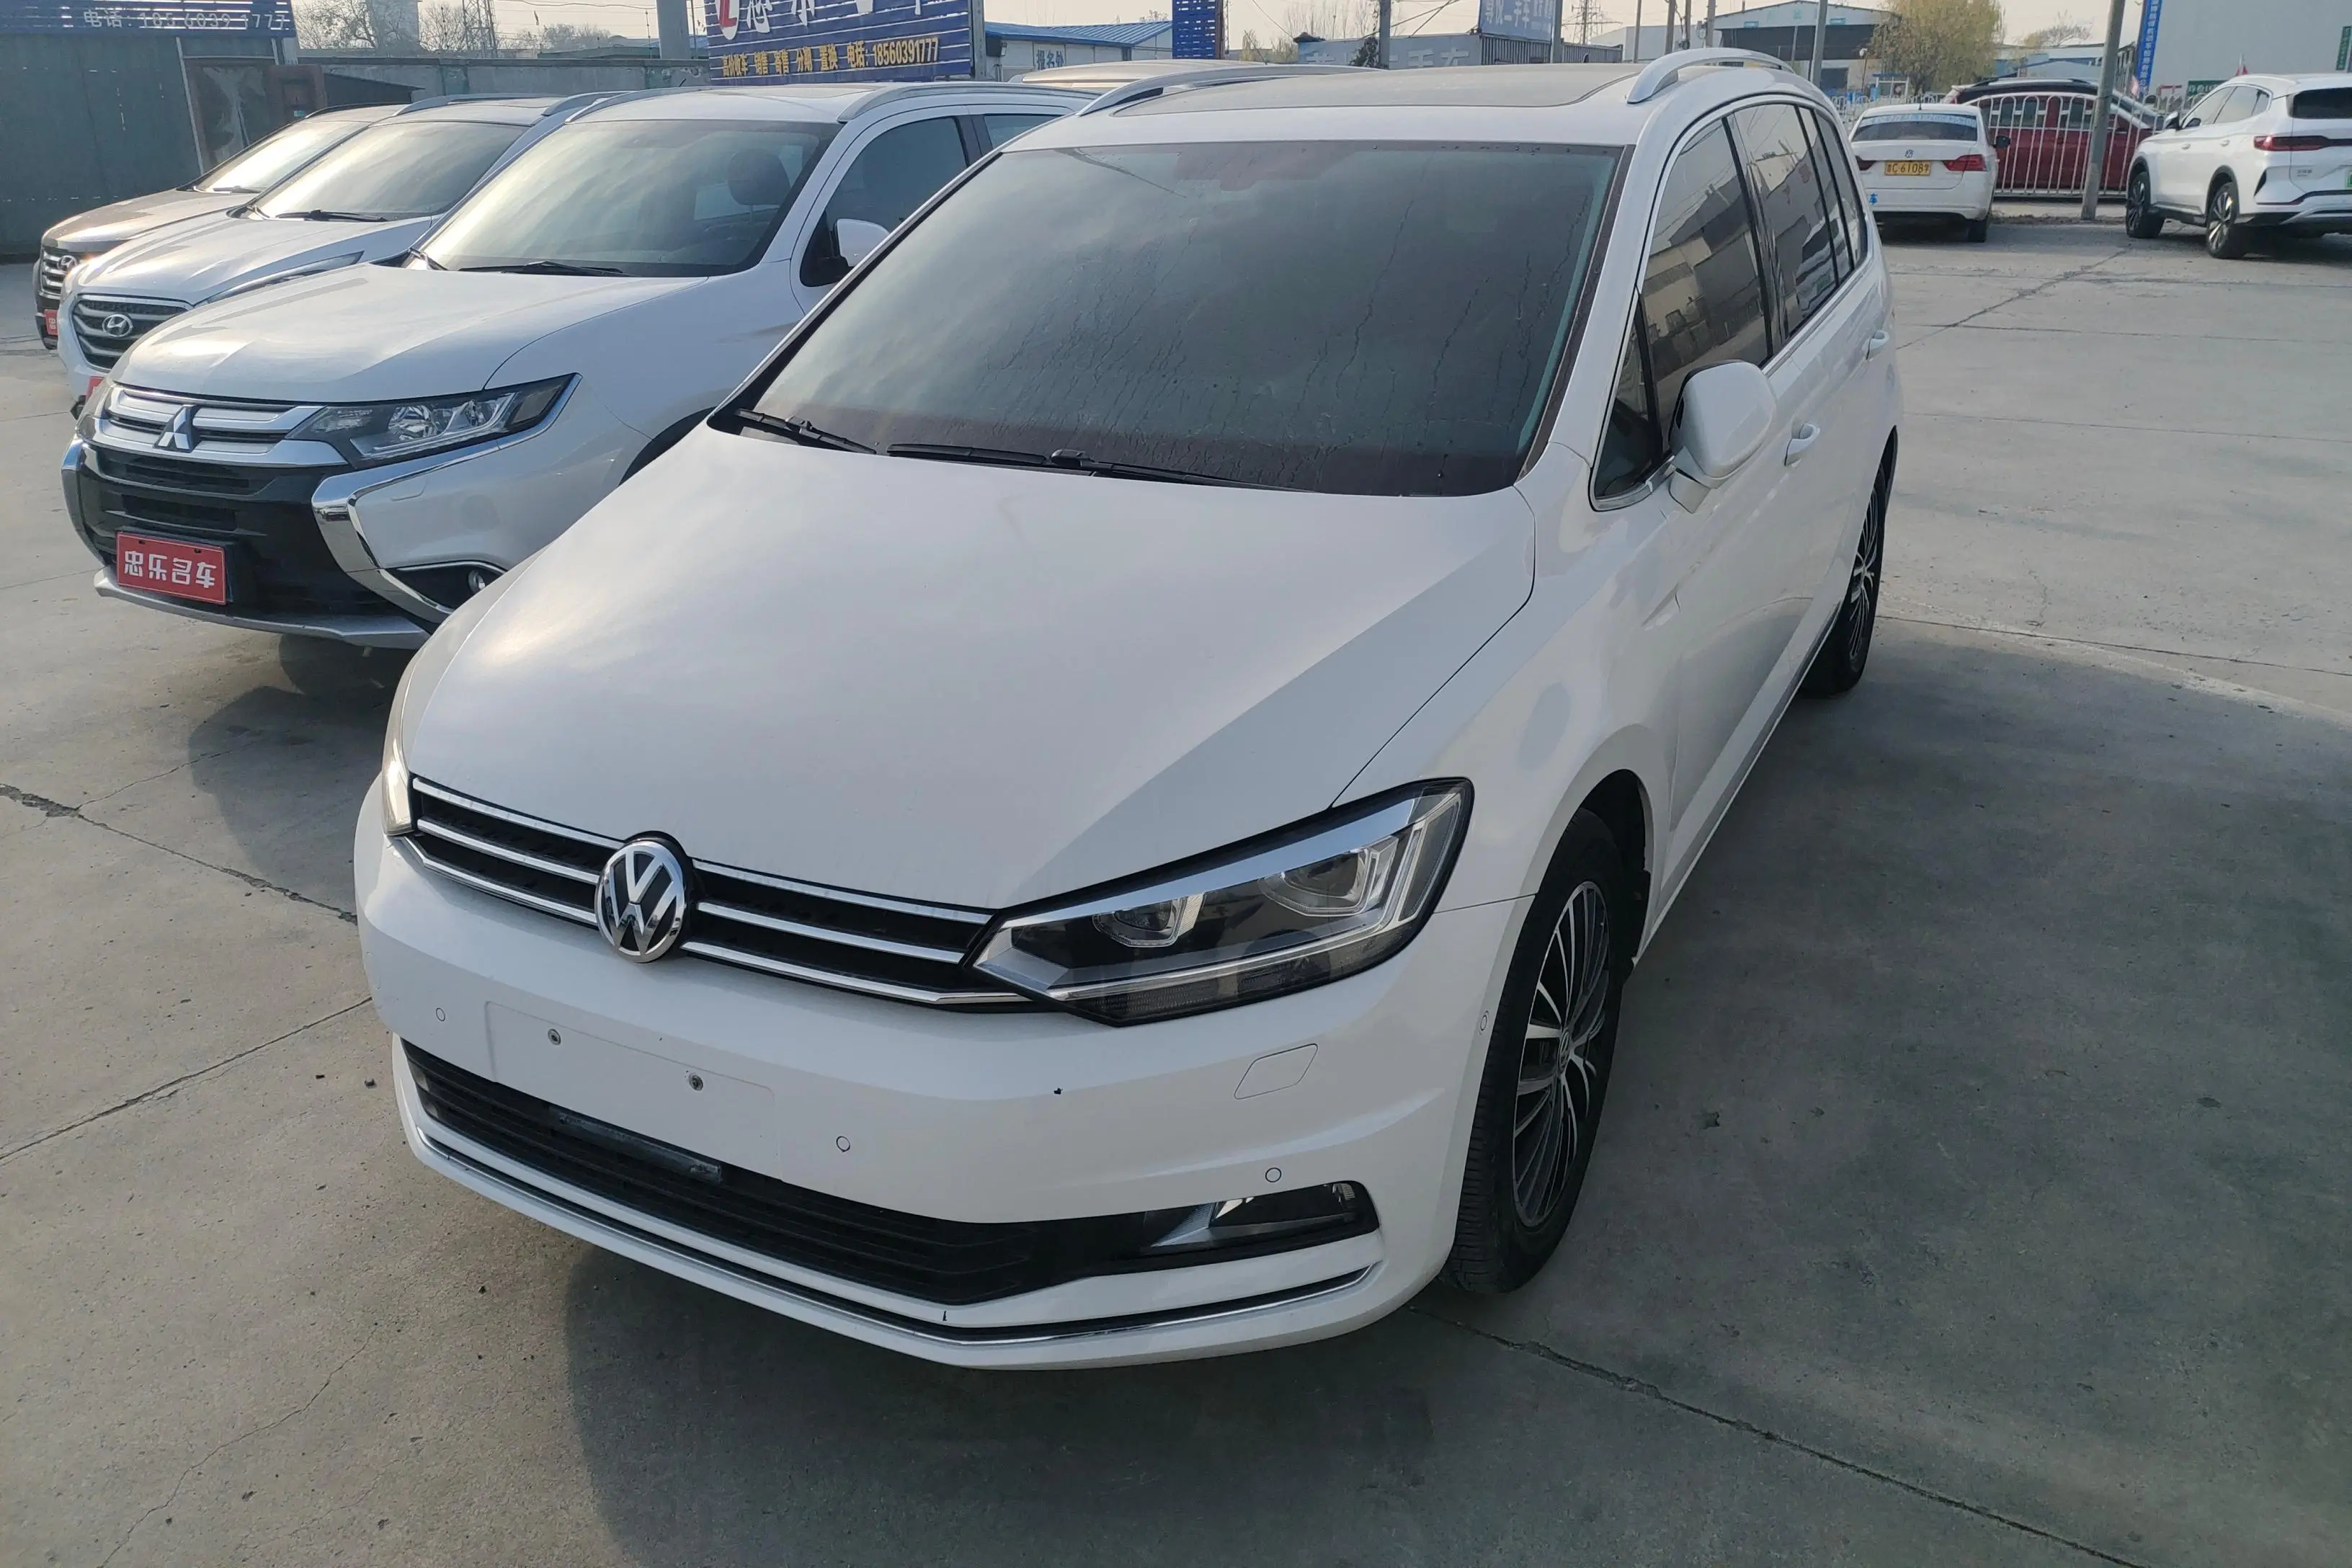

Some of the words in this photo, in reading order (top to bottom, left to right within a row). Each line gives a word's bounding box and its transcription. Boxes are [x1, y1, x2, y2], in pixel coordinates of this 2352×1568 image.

[139, 12, 173, 27] 185
[184, 13, 231, 27] 6039
[241, 14, 285, 28] 1777
[819, 43, 838, 71] 置换
[124, 550, 217, 589] 忠乐名车
